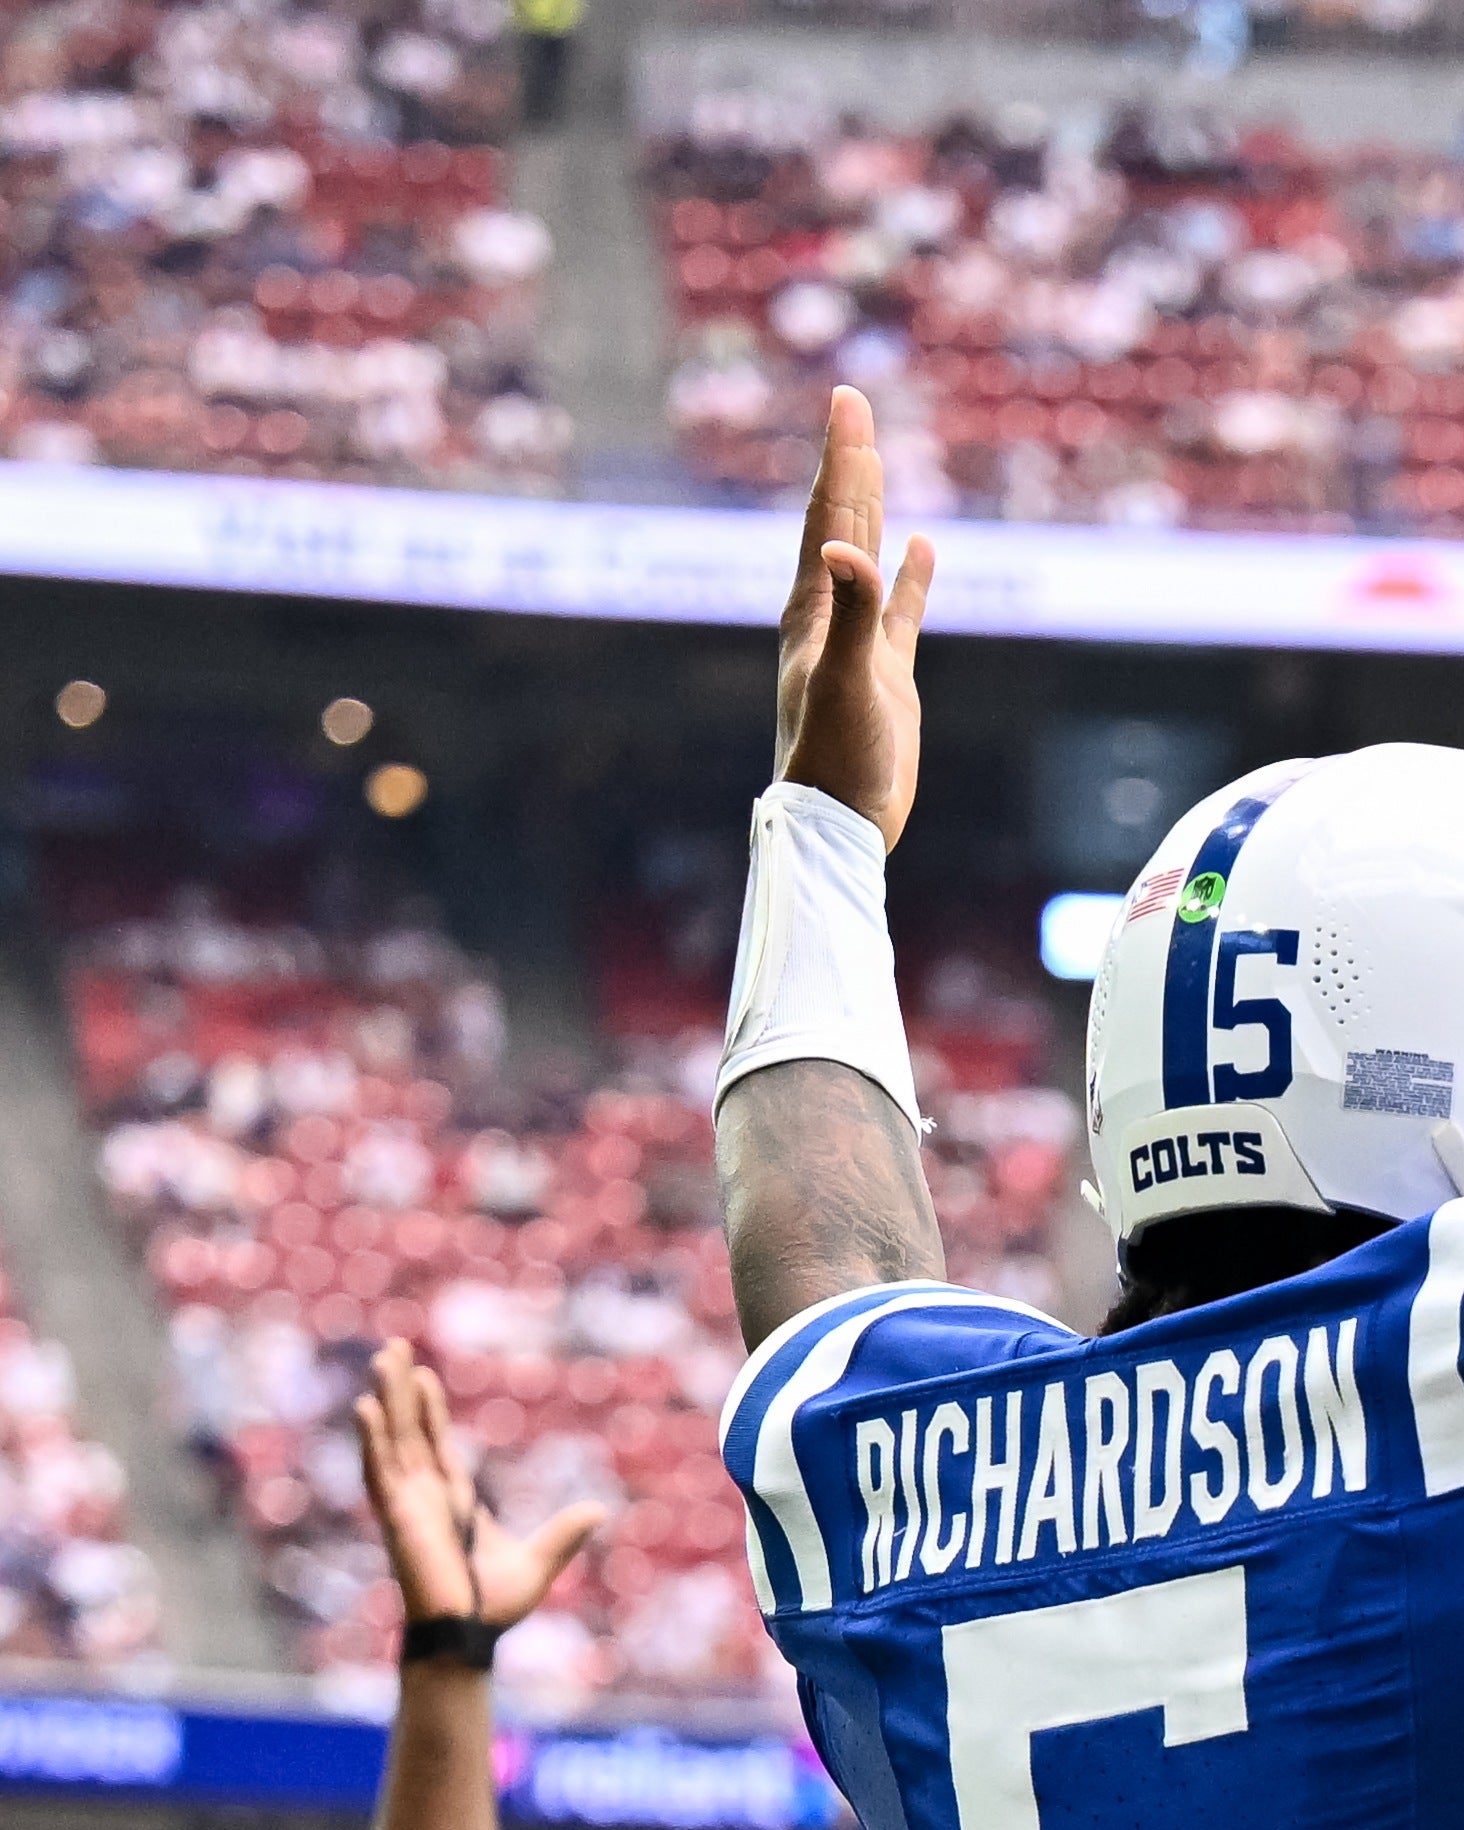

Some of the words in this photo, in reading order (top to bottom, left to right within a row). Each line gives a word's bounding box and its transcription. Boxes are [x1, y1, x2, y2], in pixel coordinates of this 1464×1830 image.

[1213, 929, 1300, 1103] 5
[1130, 1131, 1266, 1193] COLTS
[855, 1316, 1368, 1593] RICHARDSON
